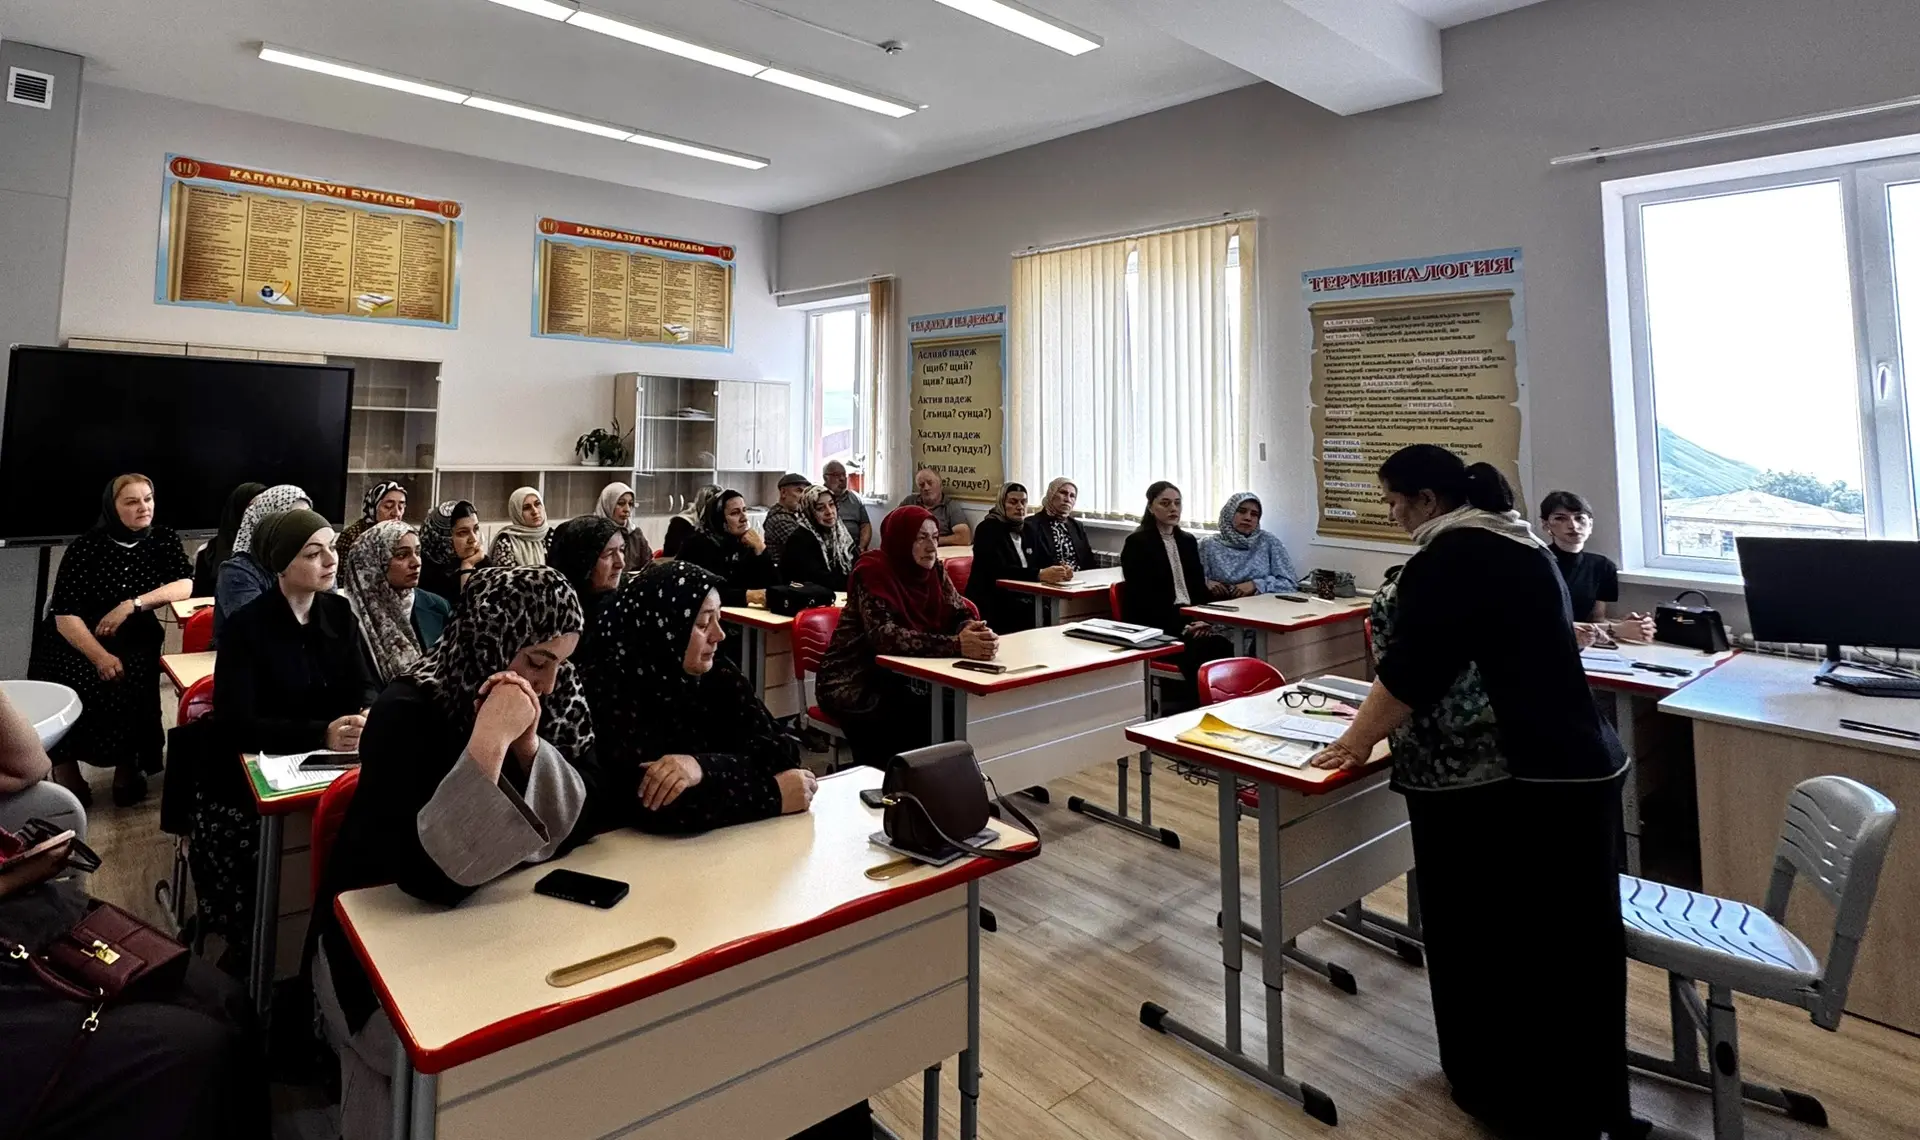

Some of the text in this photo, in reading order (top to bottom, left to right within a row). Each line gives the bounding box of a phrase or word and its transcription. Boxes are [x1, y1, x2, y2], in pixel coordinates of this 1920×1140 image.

[576, 226, 641, 243] РАЗБОРАЗУЛ
[1309, 256, 1515, 292] ТЕРМИНАЛОГИЯ
[949, 347, 977, 358] падеж
[923, 361, 973, 375] (щиб? щий?
[923, 375, 972, 386] щив? щал?)
[917, 395, 972, 405] Актив падеж
[923, 408, 992, 420] (лъица? сунца?)
[917, 429, 980, 440] Хаслъул падеж
[923, 443, 991, 456] (лъил? сундул?)
[948, 465, 976, 474] падеж
[952, 479, 990, 491] сундуе?)
